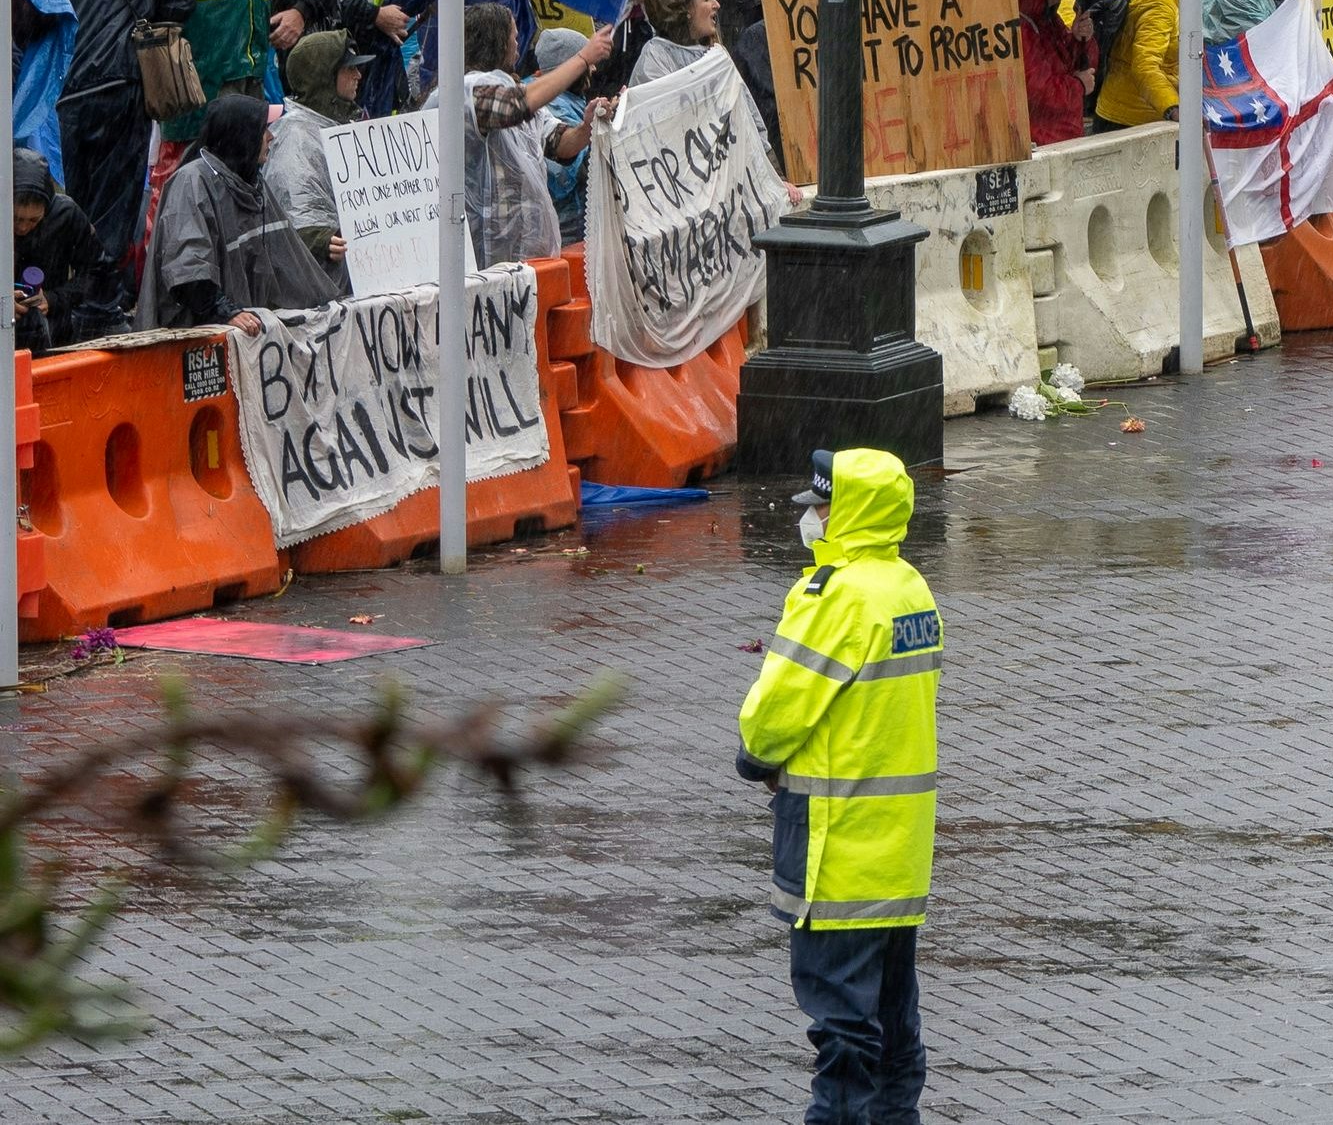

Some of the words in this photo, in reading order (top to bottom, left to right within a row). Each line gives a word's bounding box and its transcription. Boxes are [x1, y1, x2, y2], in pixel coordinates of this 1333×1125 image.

[893, 34, 923, 76] TO
[929, 18, 1020, 72] PROTEST
[329, 118, 439, 184] JACINDA
[340, 186, 370, 211] FROM
[372, 183, 391, 202] ONE
[393, 178, 421, 198] MOTHER
[423, 178, 434, 193] TO
[631, 148, 694, 216] FOR
[385, 213, 402, 229] OUR
[402, 208, 421, 224] NEXT
[188, 348, 218, 371] RSEA
[189, 371, 202, 382] FOR
[204, 367, 219, 380] HIRE
[282, 386, 440, 503] AGAINST
[894, 615, 939, 650] POLICE
